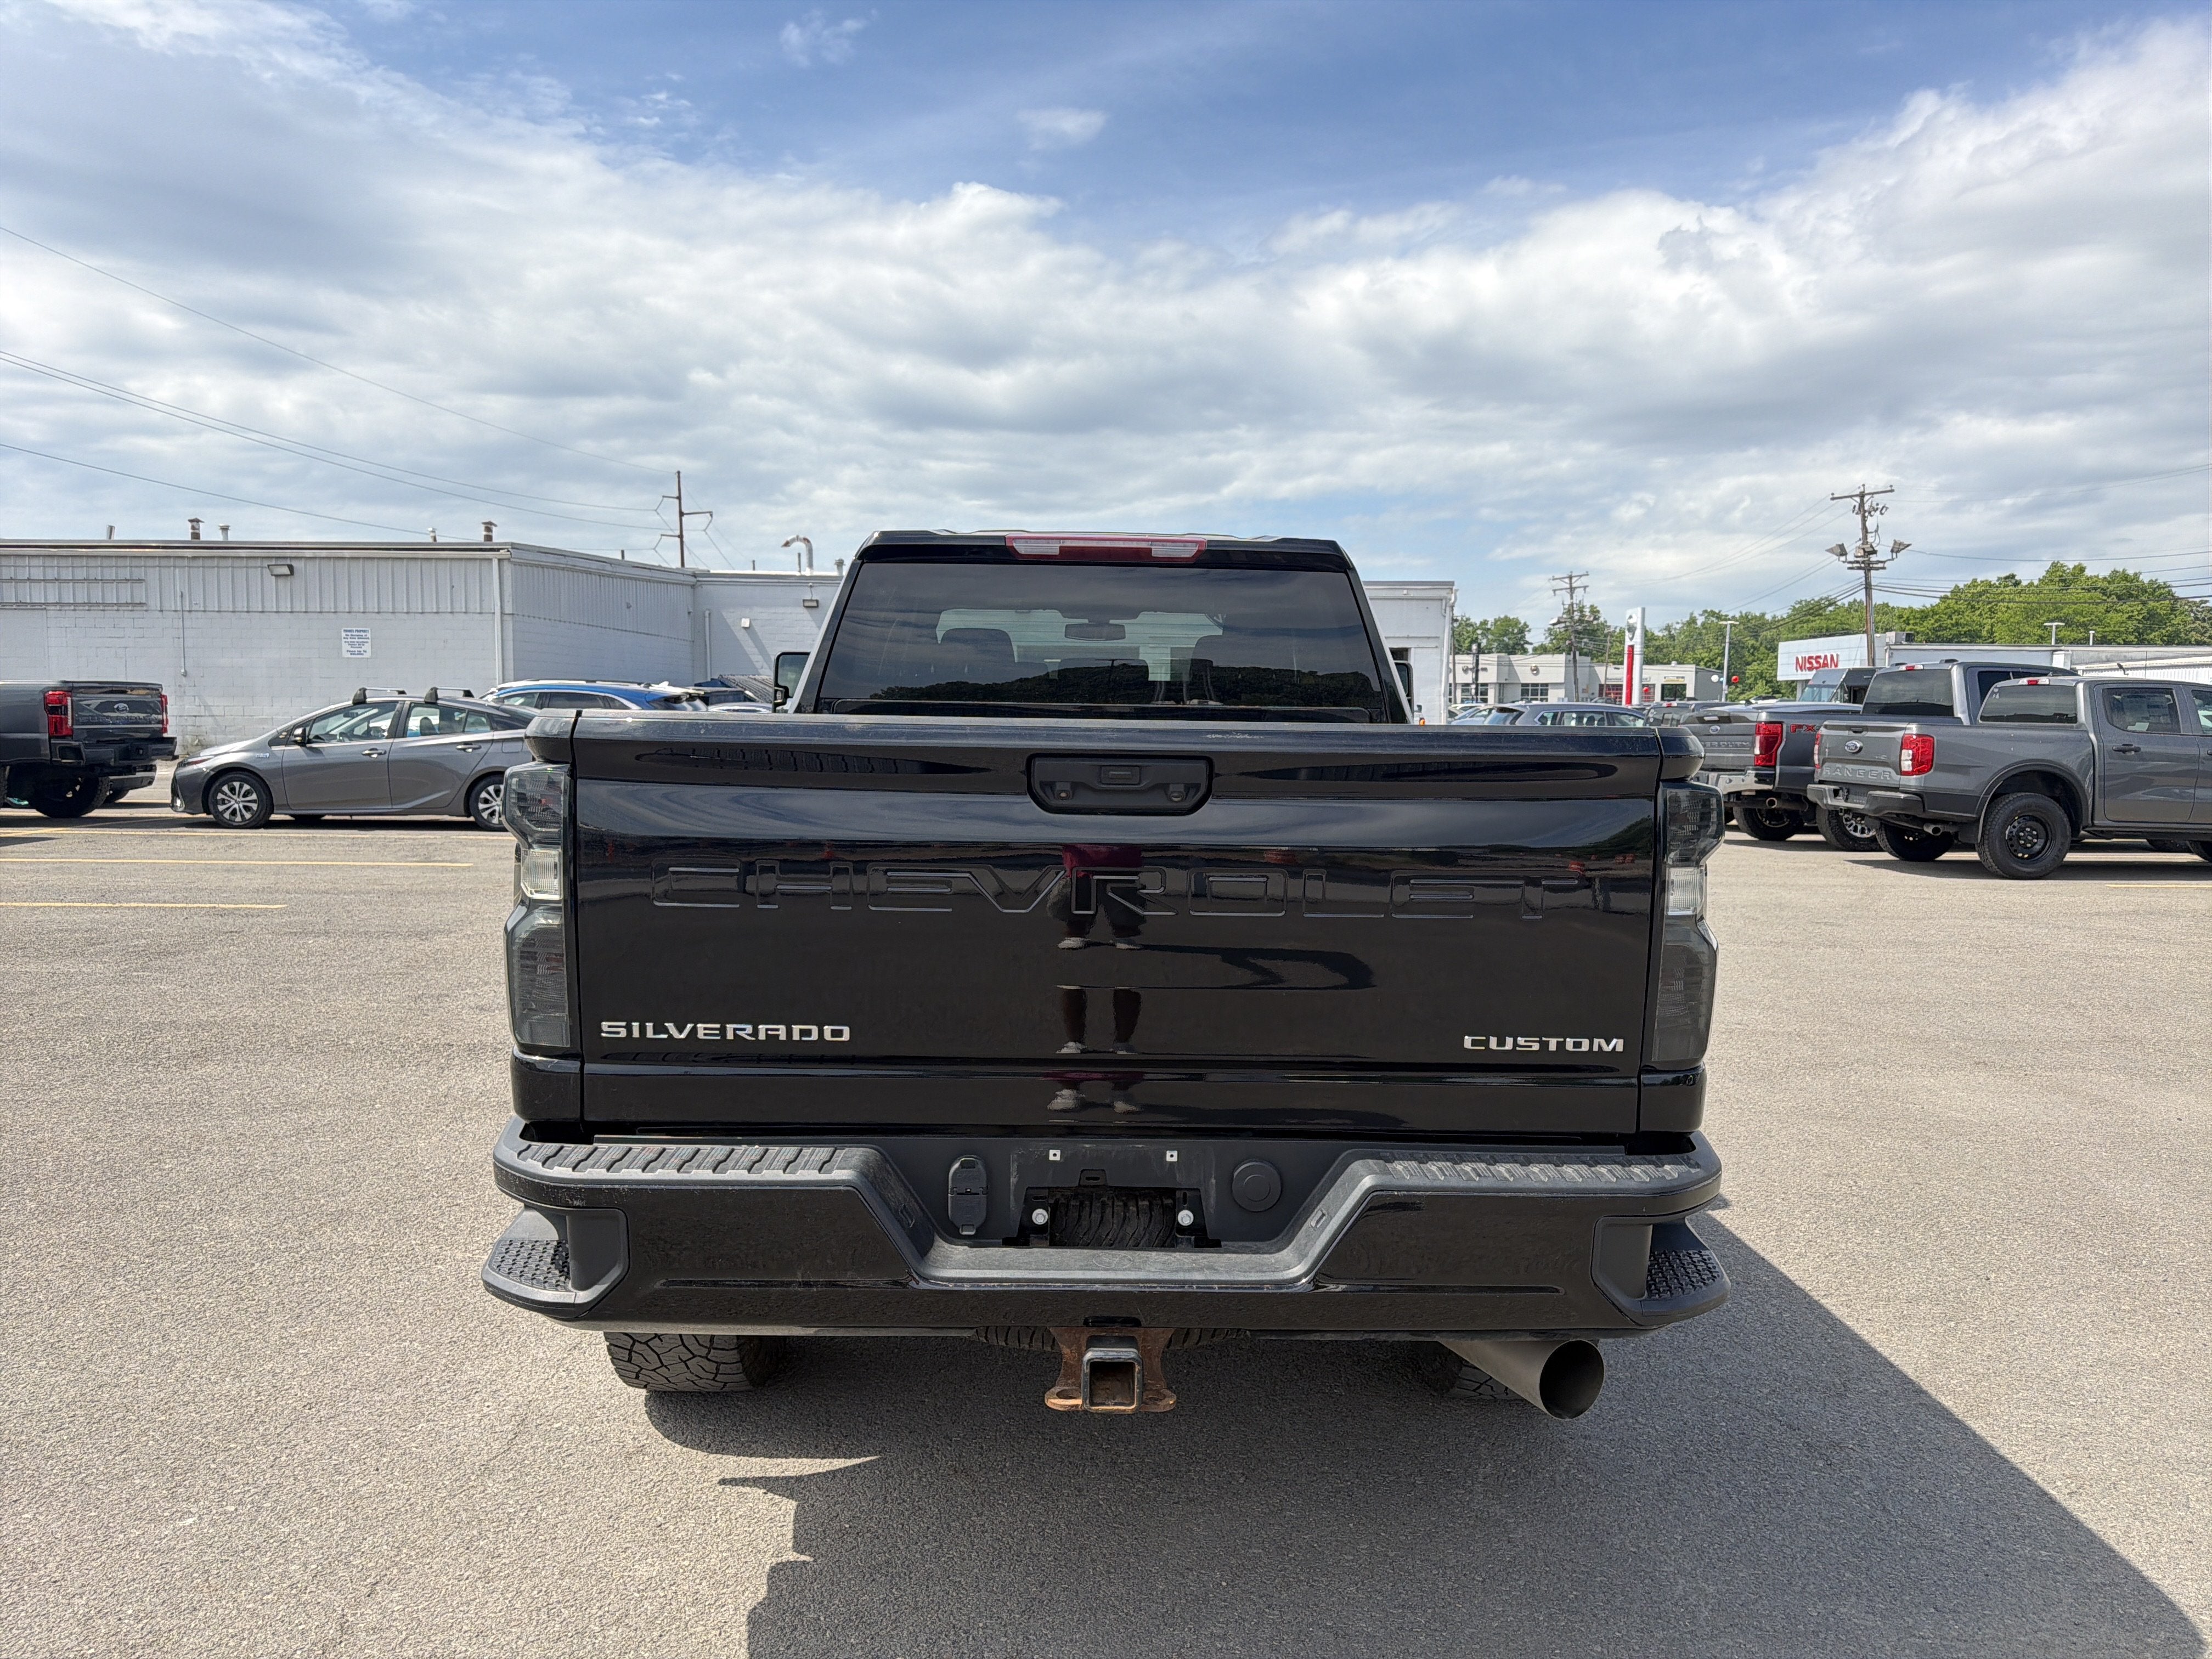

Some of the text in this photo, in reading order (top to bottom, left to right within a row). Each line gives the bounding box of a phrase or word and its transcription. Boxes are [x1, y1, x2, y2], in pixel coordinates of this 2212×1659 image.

[1796, 653, 1839, 672] NISSAN
[1822, 764, 1892, 781] RANGER
[651, 857, 1584, 919] CHEVROLET
[601, 1021, 851, 1042] SILVERADO
[1463, 1035, 1624, 1053] CUSTOM
